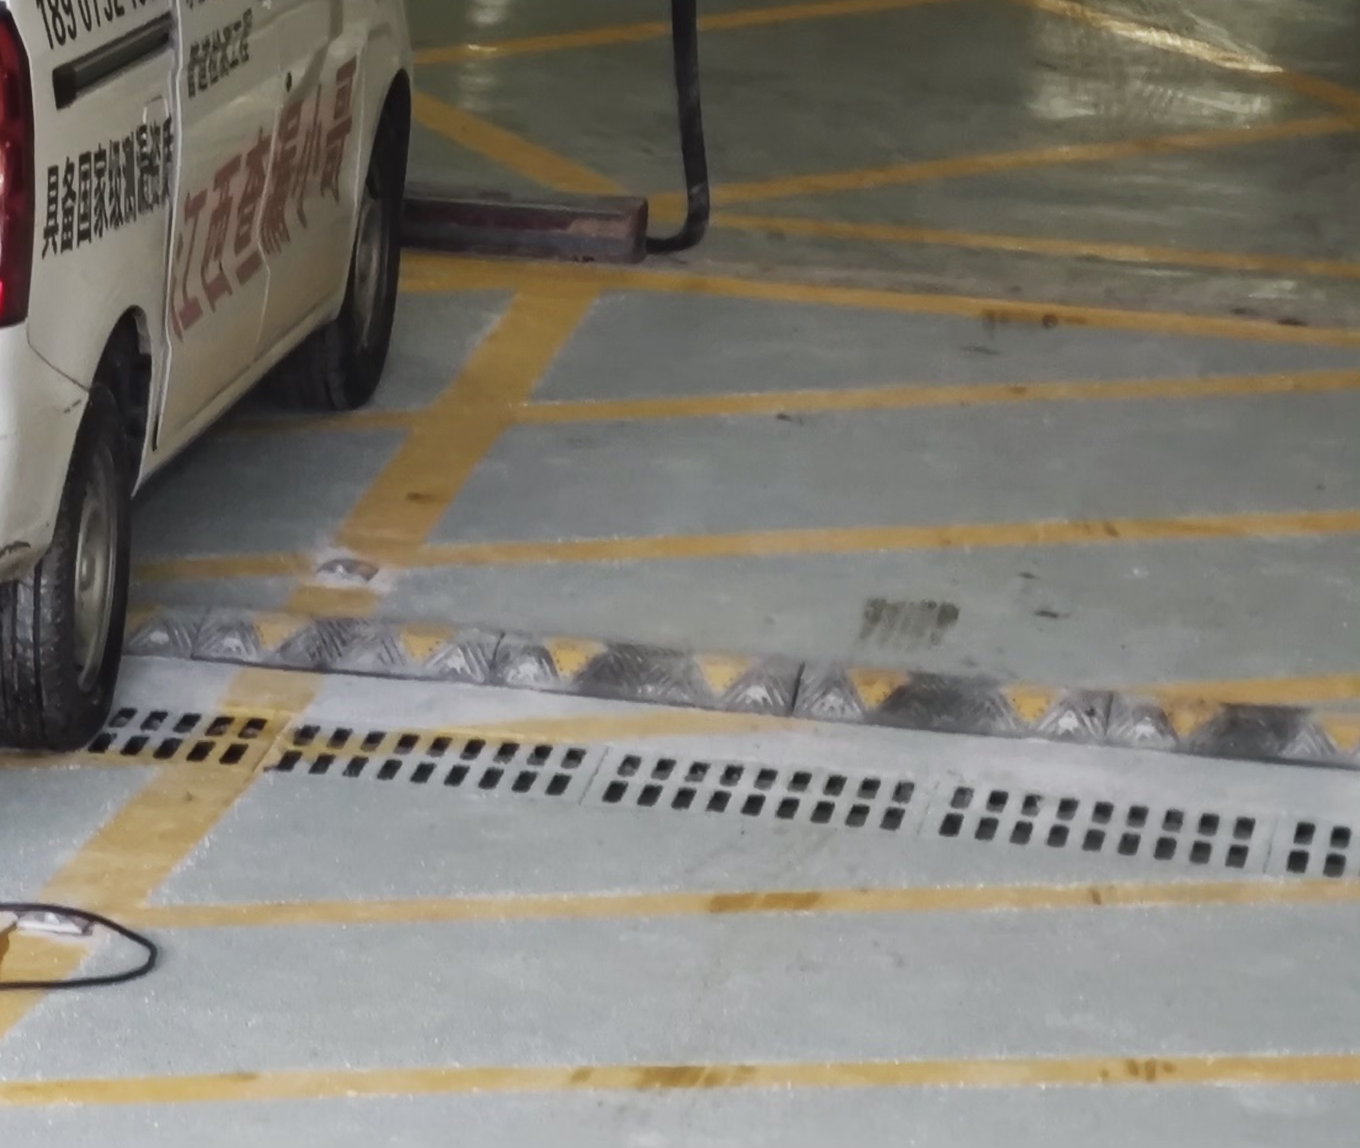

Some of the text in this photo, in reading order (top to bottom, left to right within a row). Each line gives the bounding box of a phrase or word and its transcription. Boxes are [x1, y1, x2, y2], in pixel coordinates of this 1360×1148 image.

[168, 55, 357, 342] 江西查漏小哥
